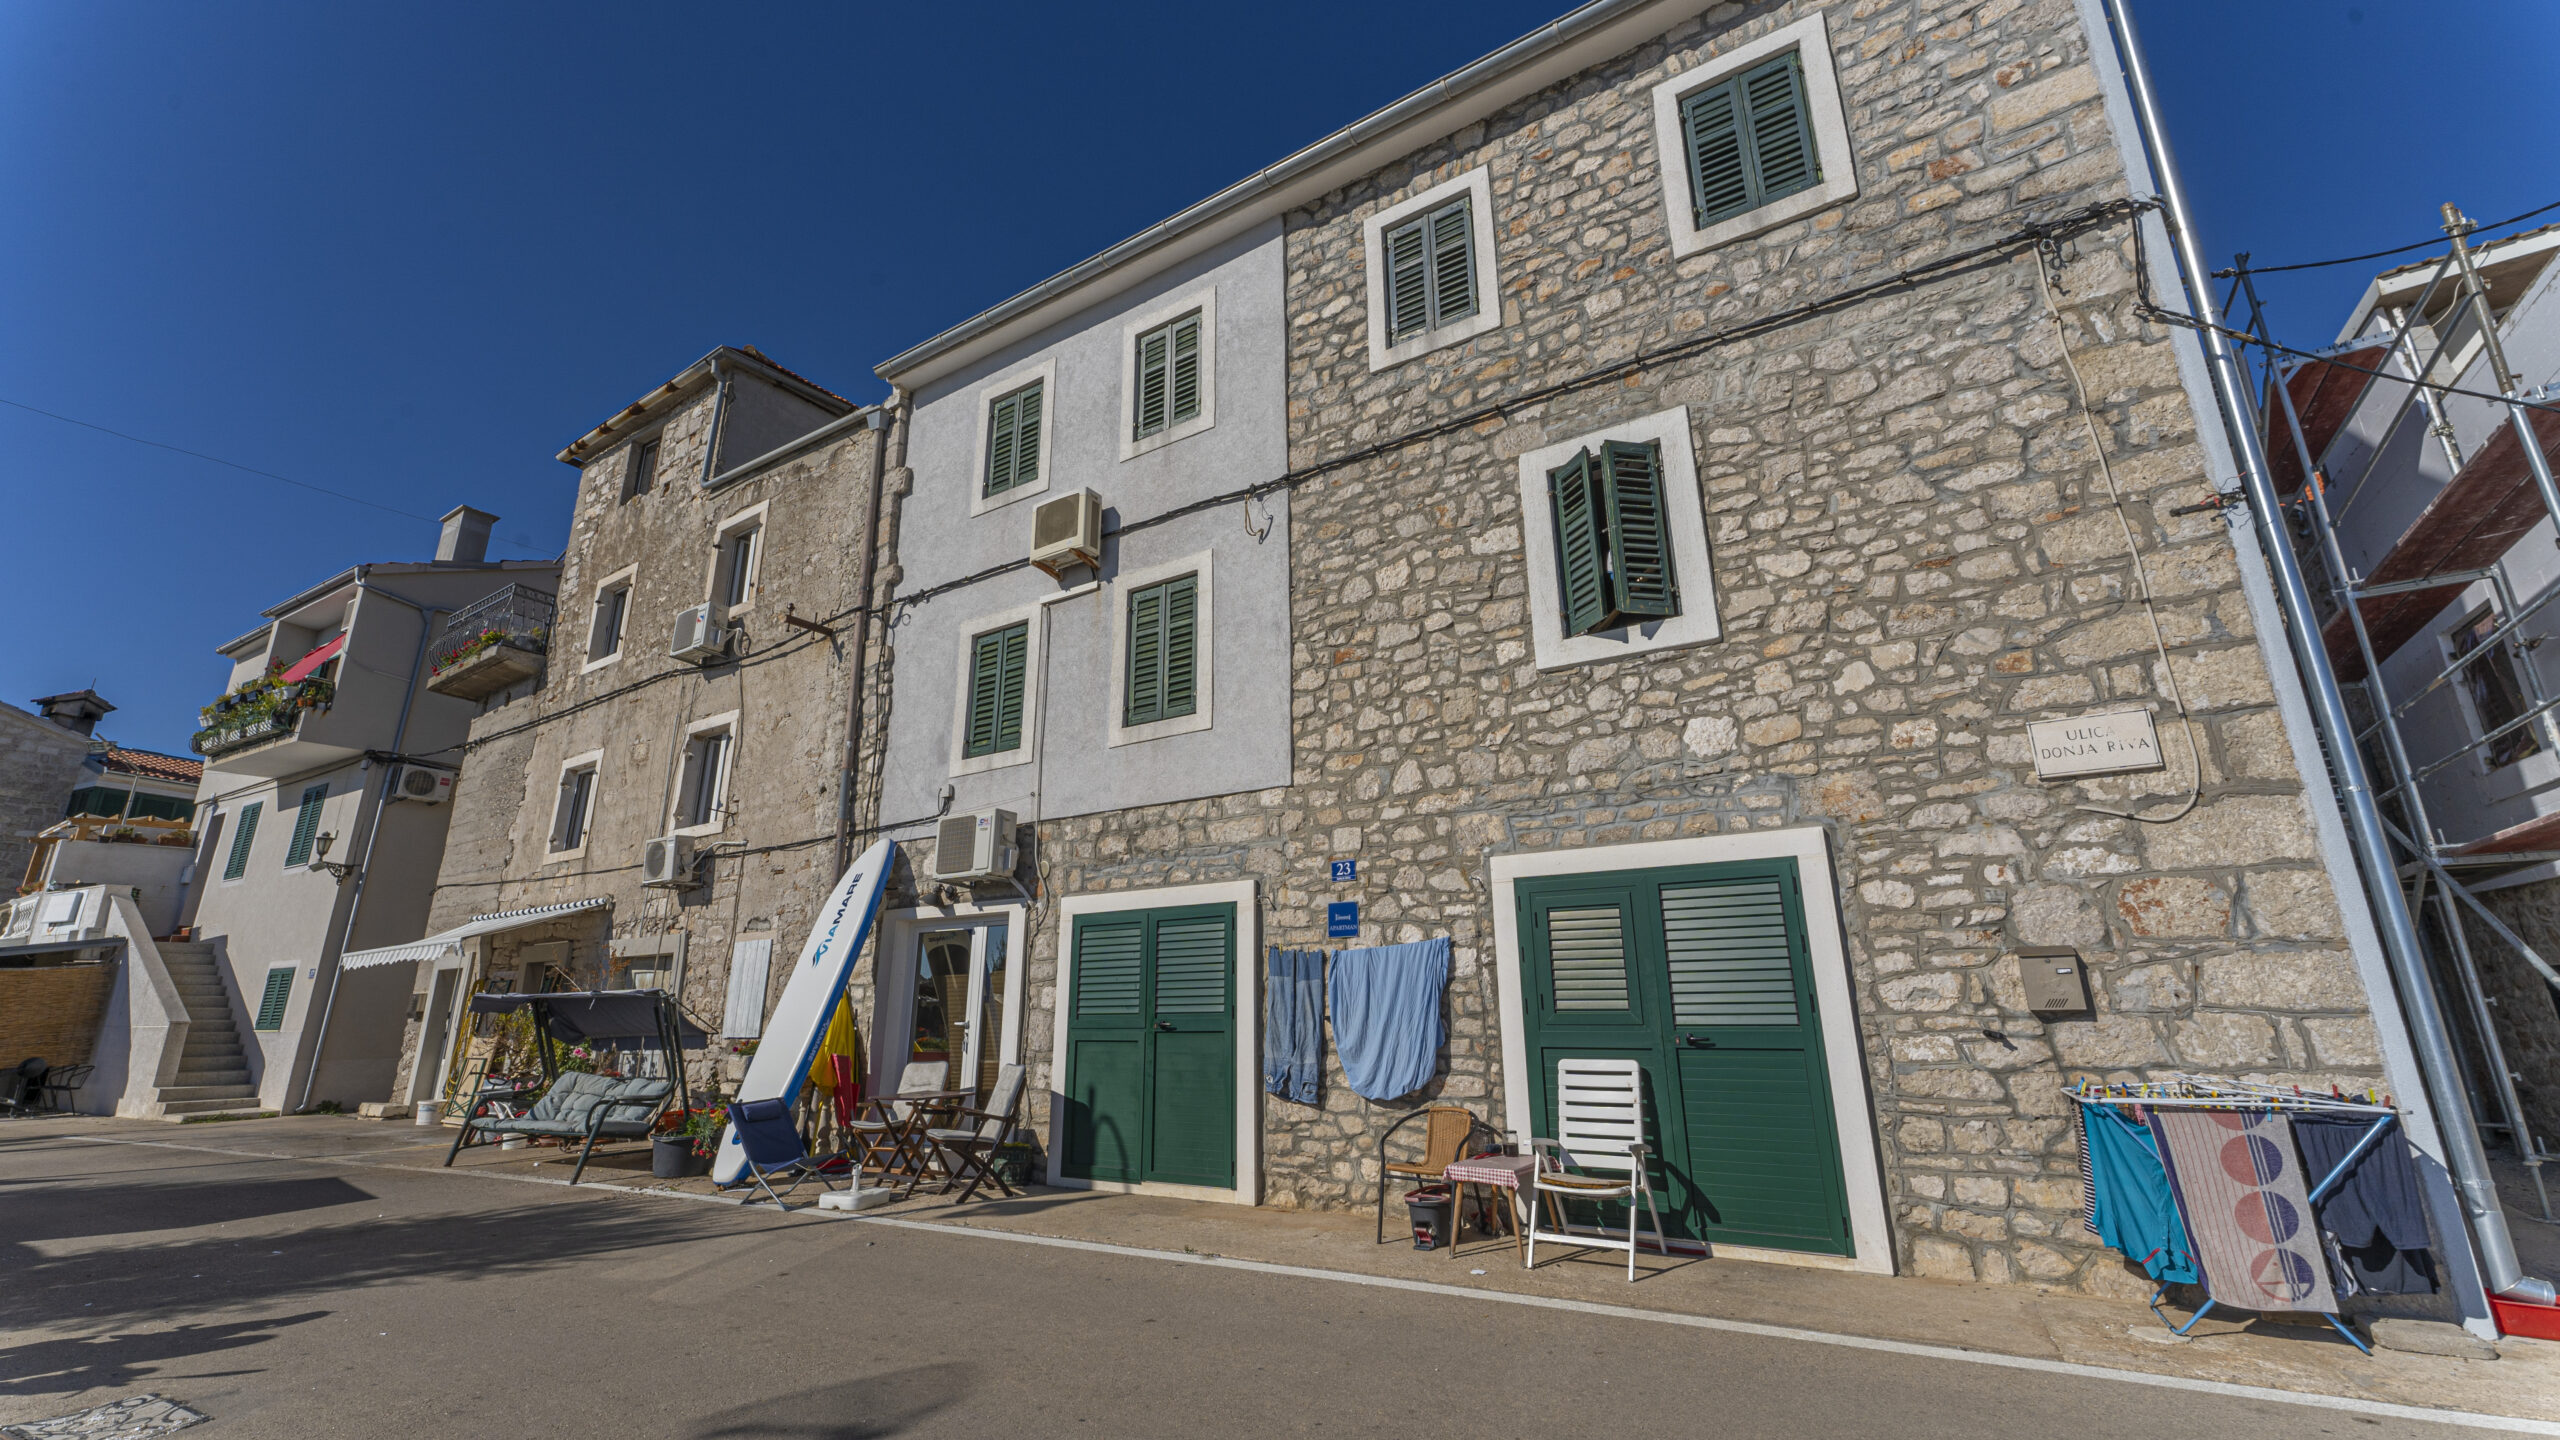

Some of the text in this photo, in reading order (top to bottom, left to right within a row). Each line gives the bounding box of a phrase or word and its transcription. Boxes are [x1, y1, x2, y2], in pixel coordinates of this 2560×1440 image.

[2065, 726, 2115, 741] ULICA
[2041, 743, 2099, 760] DONJA
[1336, 862, 1351, 876] 23
[813, 872, 863, 968] VIAMARE
